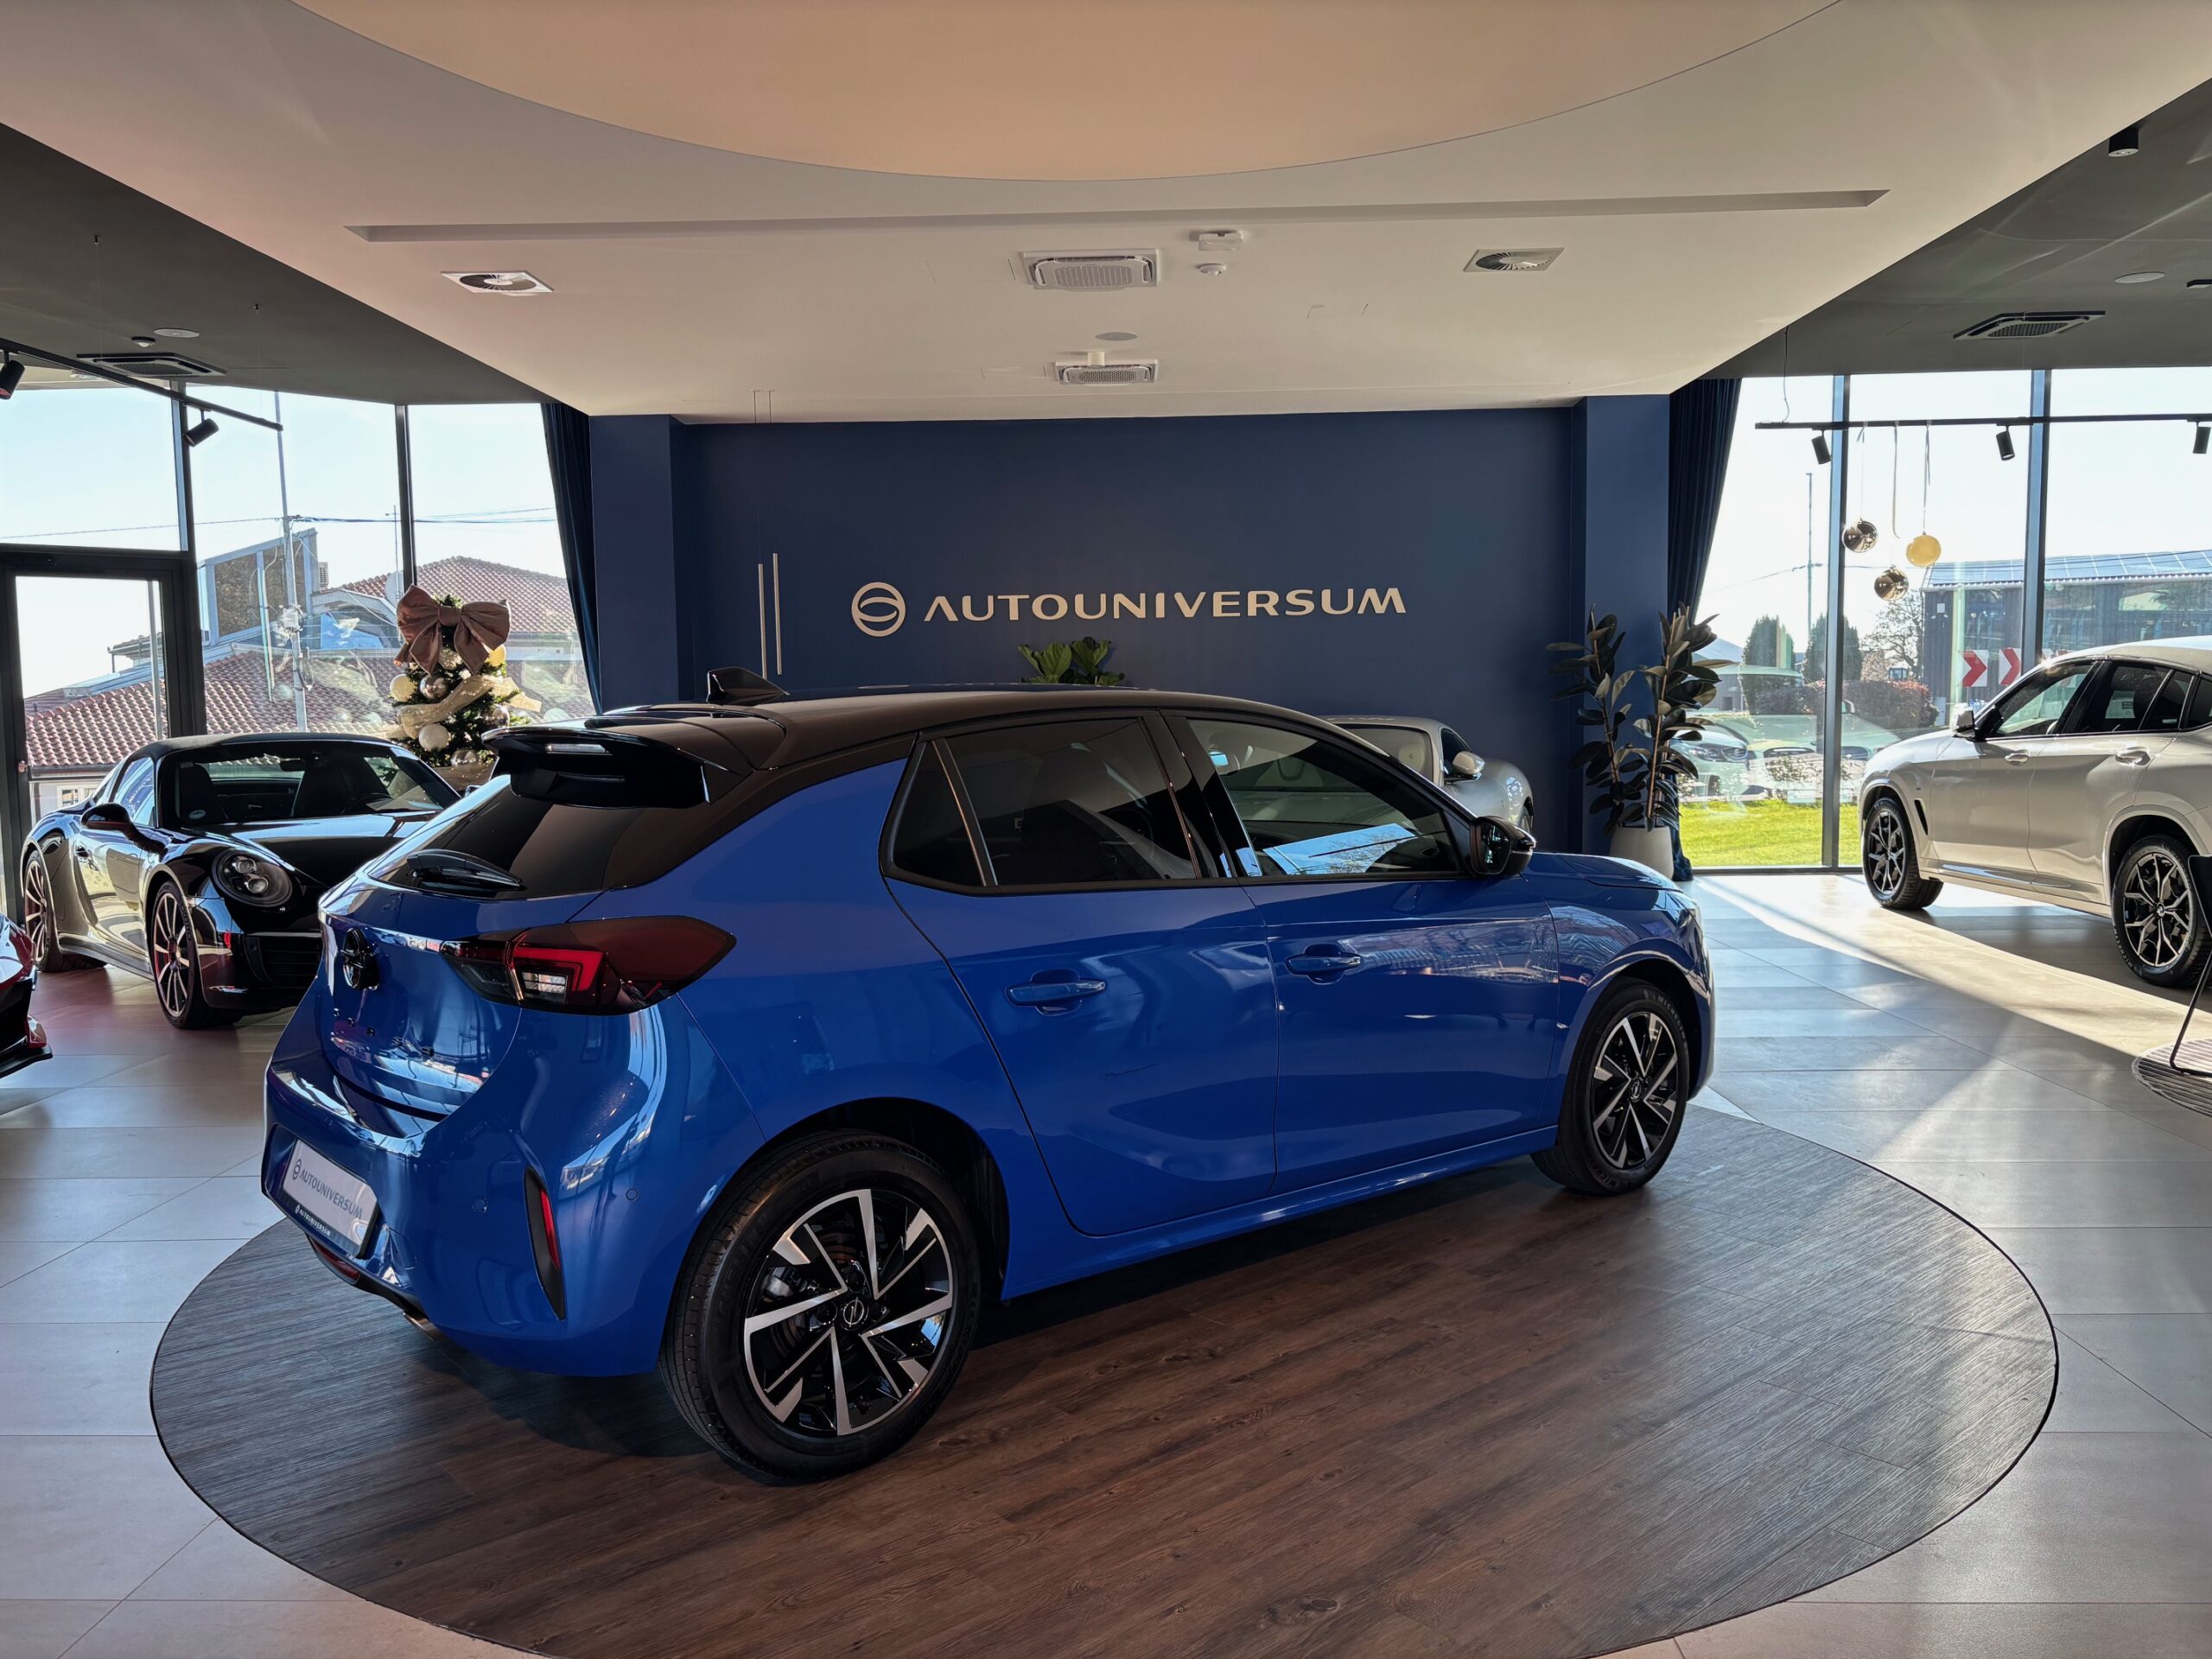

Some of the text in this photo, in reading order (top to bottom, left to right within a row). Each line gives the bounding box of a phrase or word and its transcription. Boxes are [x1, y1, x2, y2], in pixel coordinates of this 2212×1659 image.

[924, 587, 1407, 621] AUTOUNIVERSUM
[299, 1169, 363, 1218] AUTOUNIVERSUM
[298, 1209, 331, 1236] AUTOUNIVERSUM
